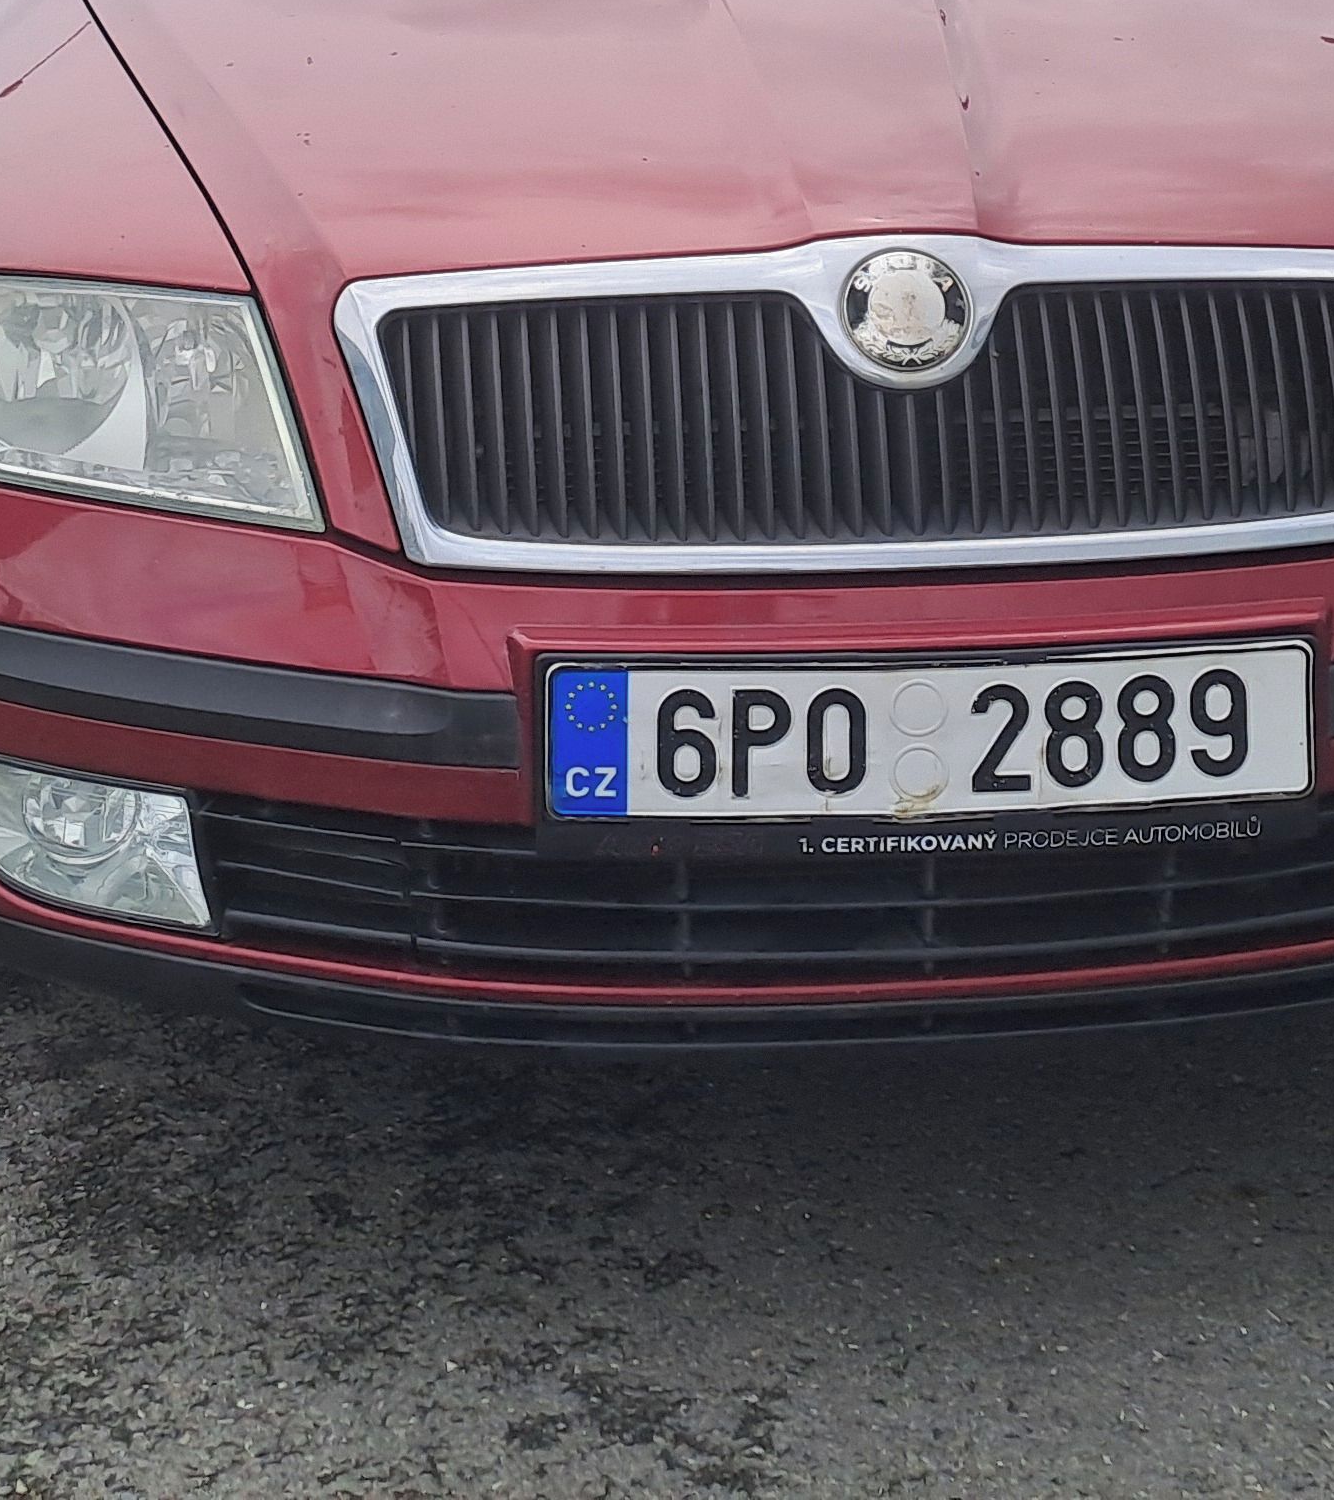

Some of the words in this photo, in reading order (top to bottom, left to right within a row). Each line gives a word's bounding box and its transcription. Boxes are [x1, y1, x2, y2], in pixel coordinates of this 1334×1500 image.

[970, 668, 1249, 793] 2889
[564, 767, 617, 798] CZ
[798, 837, 814, 854] 1.
[821, 829, 997, 854] CERTIFIKOVANÝ
[1003, 827, 1118, 850] PRODEJCE
[1123, 815, 1261, 846] AUTOMOBILŮ
